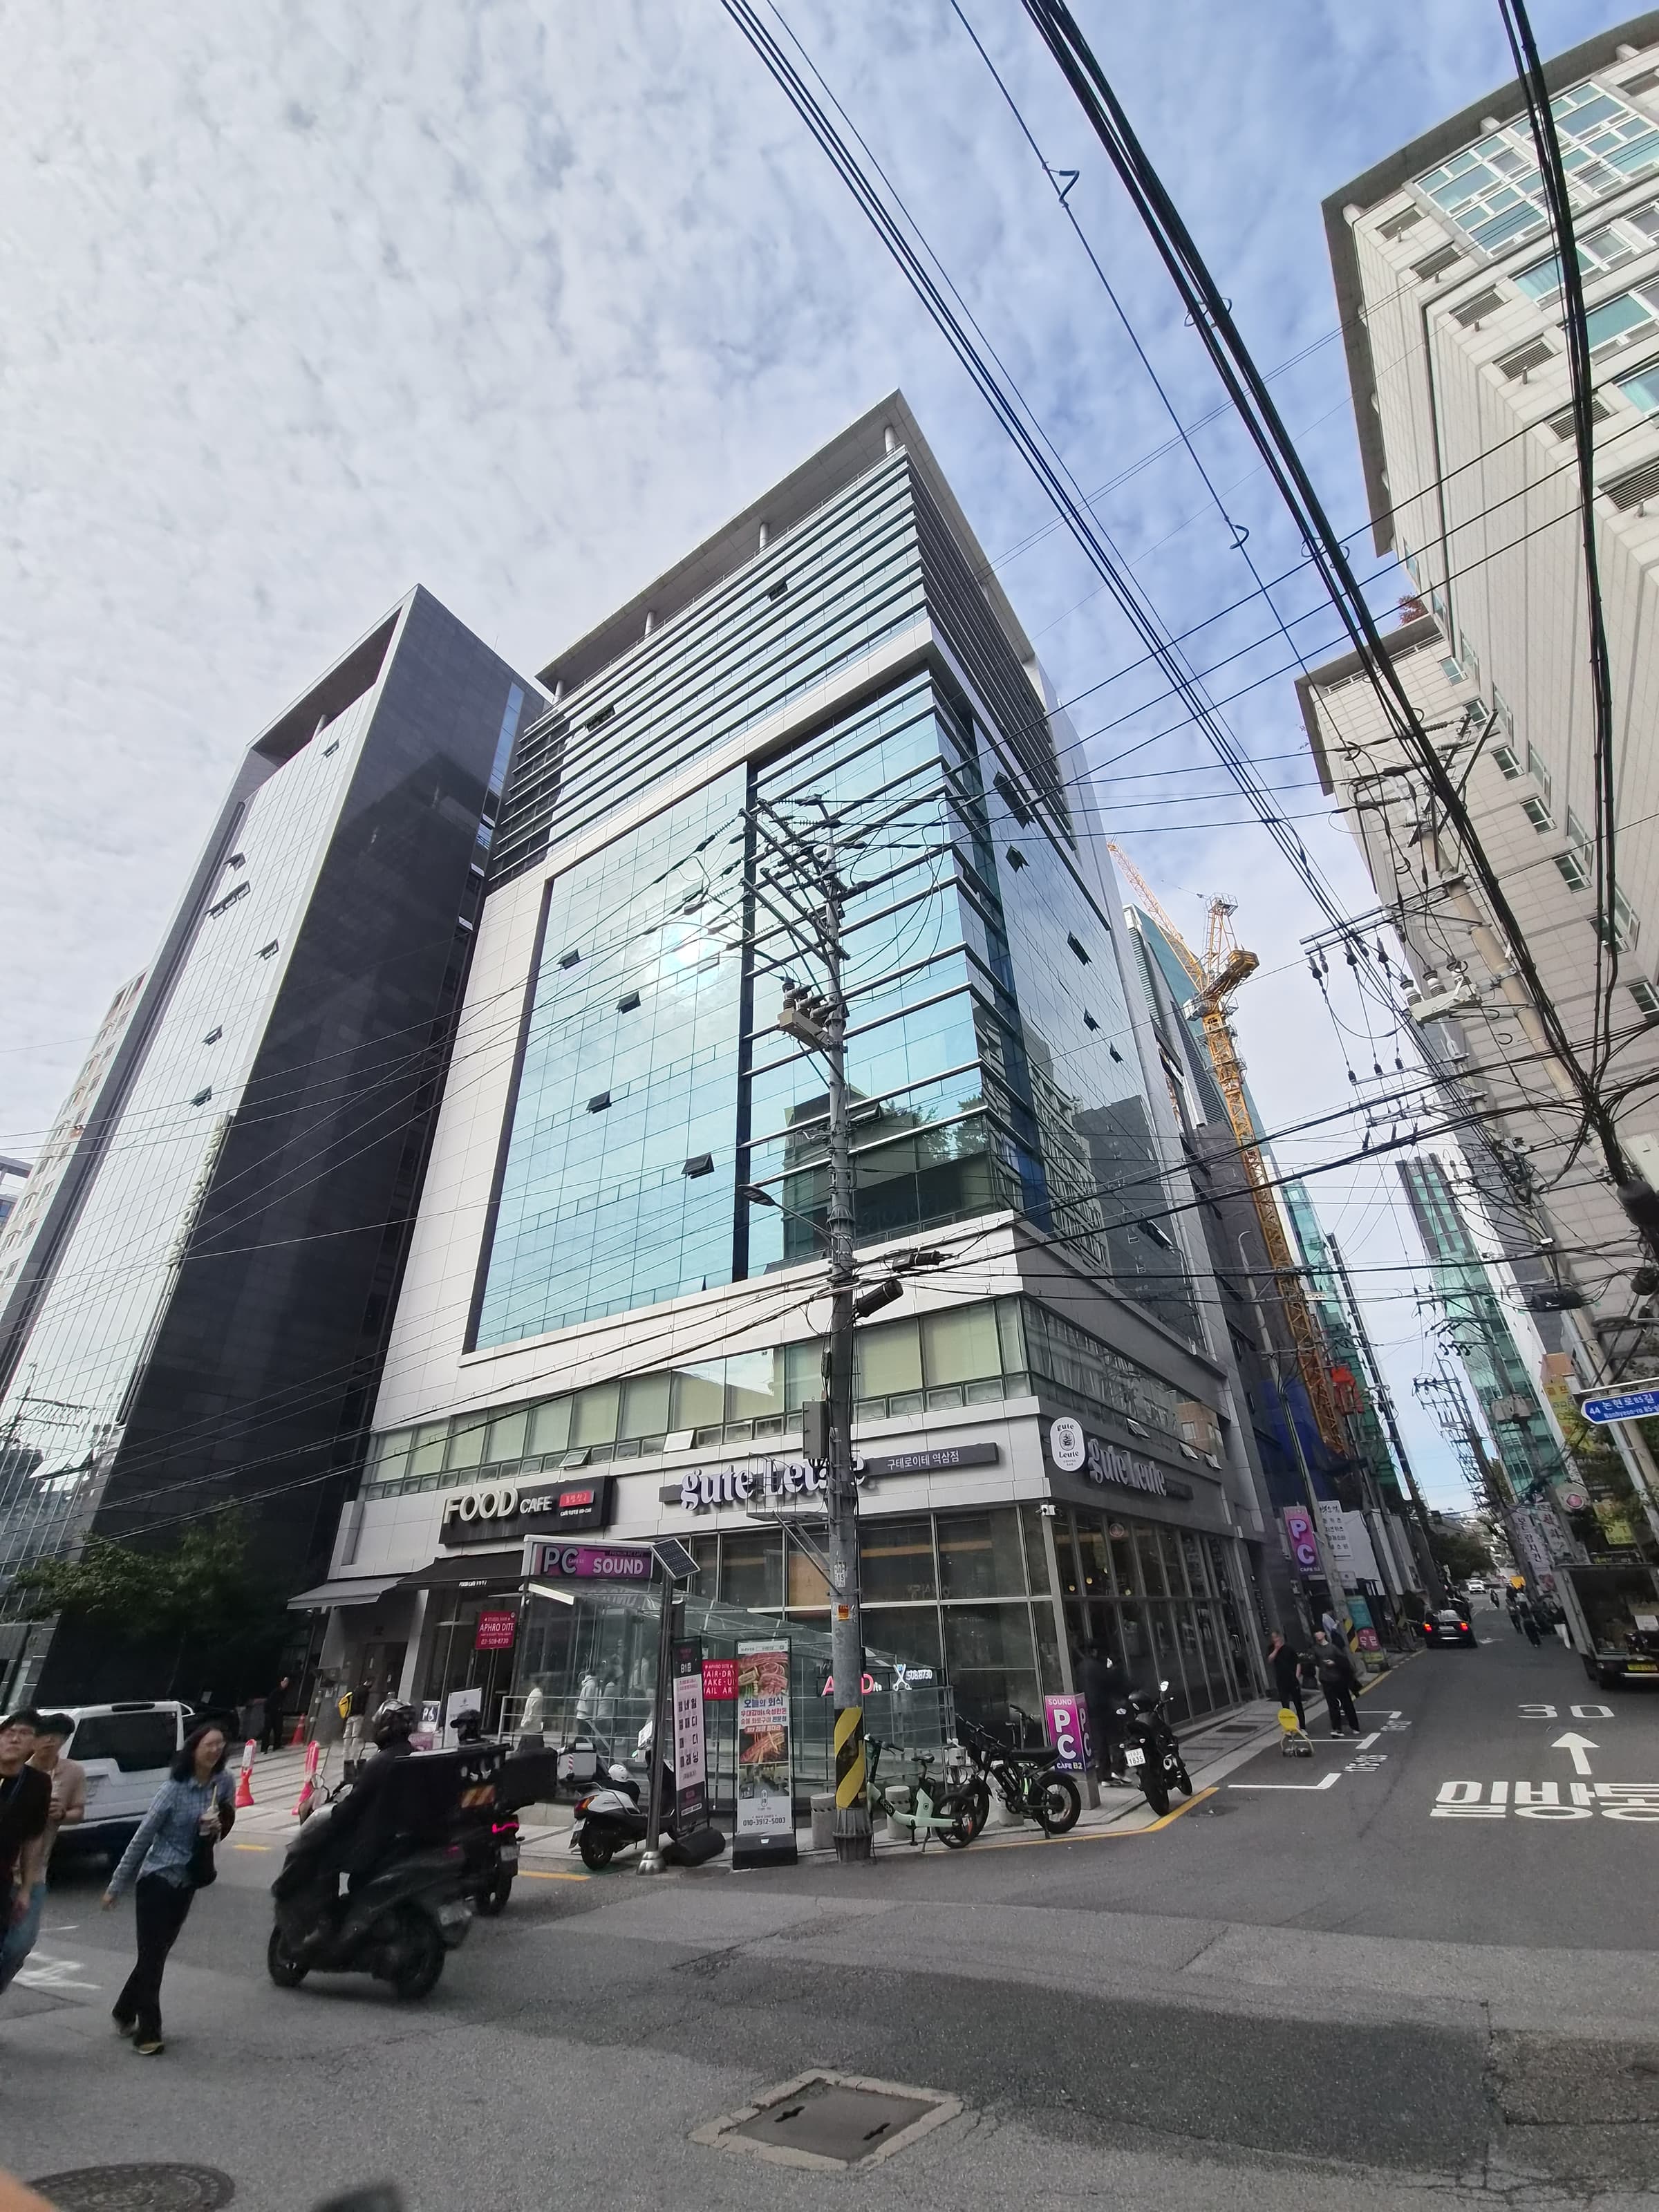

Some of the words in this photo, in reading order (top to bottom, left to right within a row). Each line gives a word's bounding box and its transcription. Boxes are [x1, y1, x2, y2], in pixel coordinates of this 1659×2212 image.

[1602, 1393, 1655, 1411] 논현로85길
[1590, 1407, 1601, 1415] 44
[1057, 1423, 1074, 1432] gute
[887, 1454, 930, 1471] 구테로이테
[932, 1450, 960, 1465] 역삼점
[1059, 1450, 1079, 1459] Leute
[680, 1468, 754, 1511] gute
[443, 1488, 518, 1524] FOOD
[519, 1495, 553, 1515] CAFE
[1289, 1519, 1315, 1564] PC
[543, 1546, 579, 1574] PC
[593, 1557, 644, 1575] SOUND
[479, 1622, 500, 1632] APHRO
[501, 1622, 514, 1631] DITE
[768, 1697, 783, 1707] 회식
[1517, 1704, 1615, 1718] 30
[1053, 1709, 1077, 1760] PC
[1073, 1761, 1083, 1770] B2
[742, 1817, 786, 1826] 010-3912-5003
